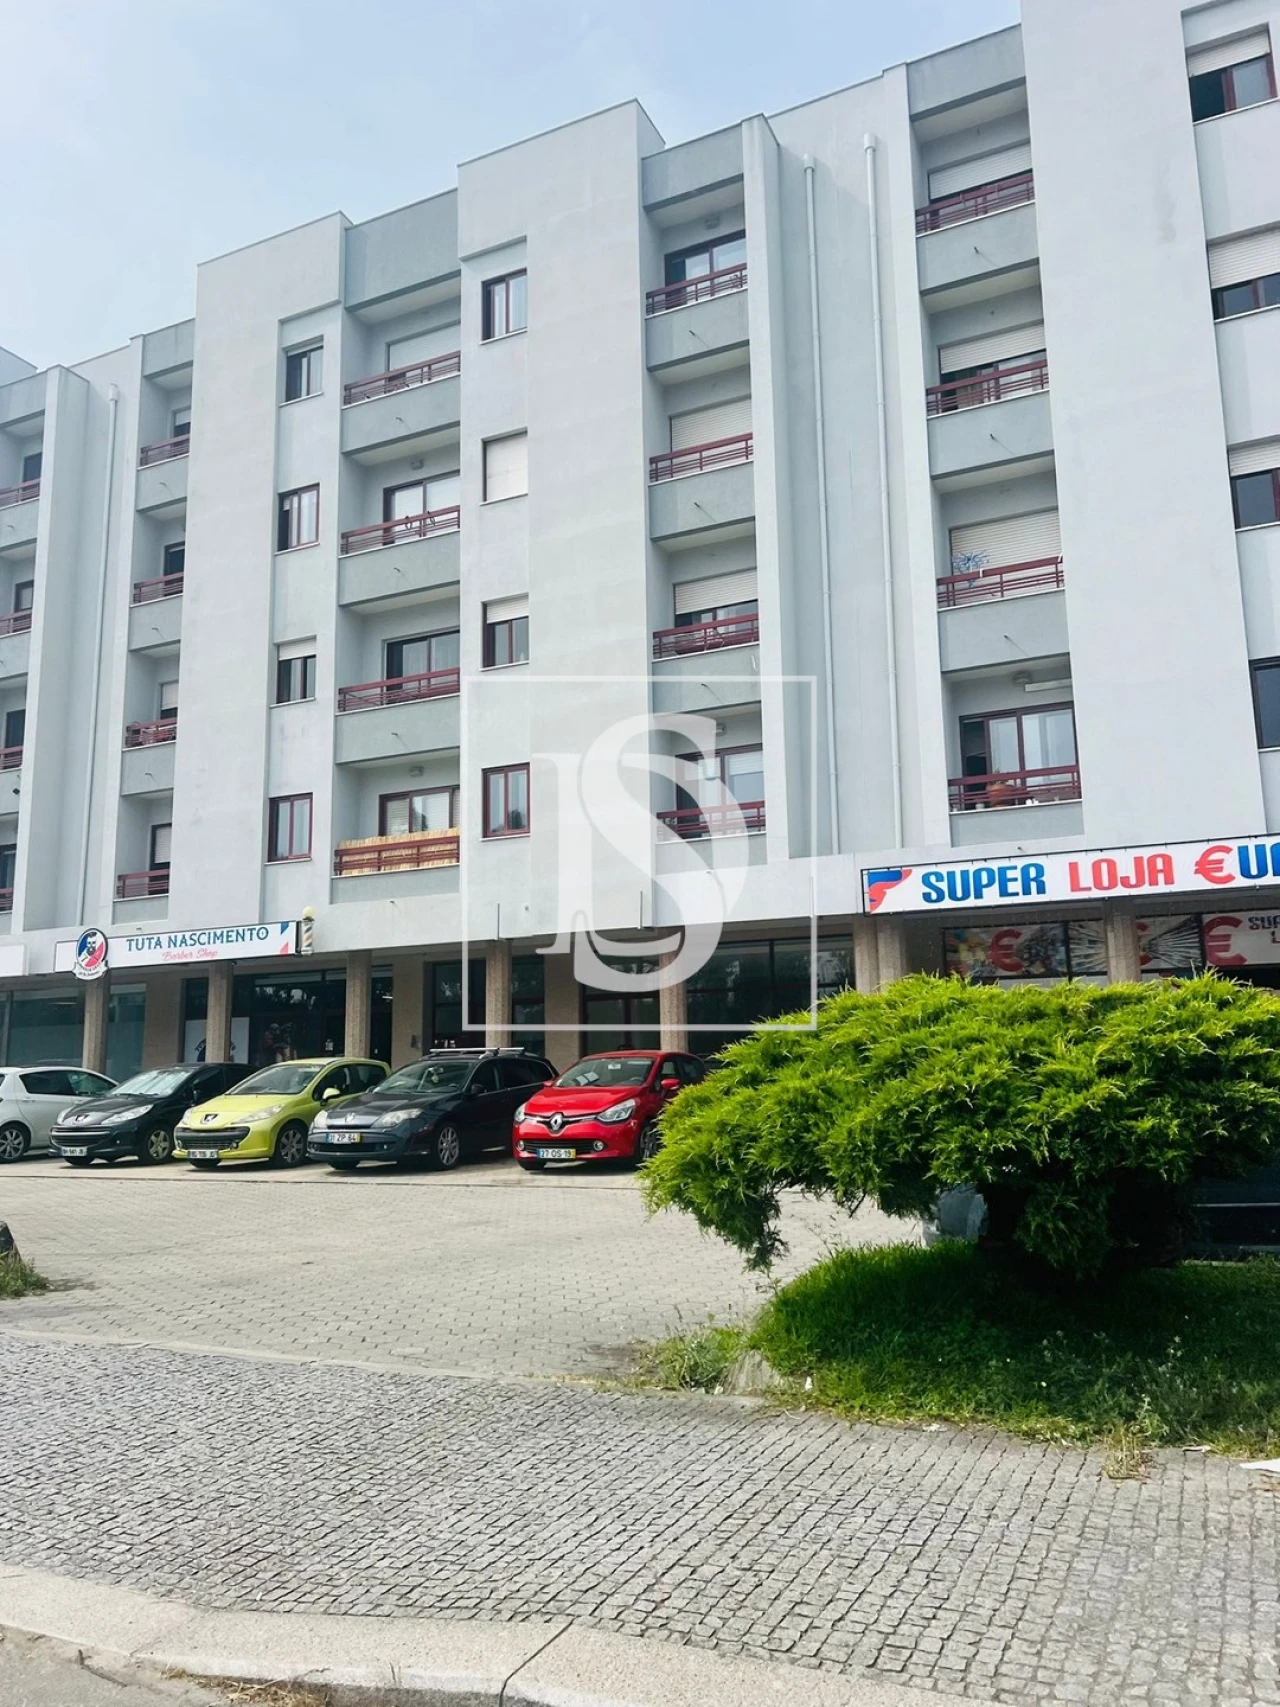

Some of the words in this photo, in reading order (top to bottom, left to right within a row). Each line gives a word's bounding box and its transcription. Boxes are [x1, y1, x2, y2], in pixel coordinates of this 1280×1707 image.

[921, 863, 1047, 904] SUPER
[1068, 853, 1175, 892] LOJA
[126, 936, 163, 952] TUTA
[167, 926, 270, 950] NASCIMENTO
[162, 950, 194, 962] Barber
[196, 947, 219, 960] Shop
